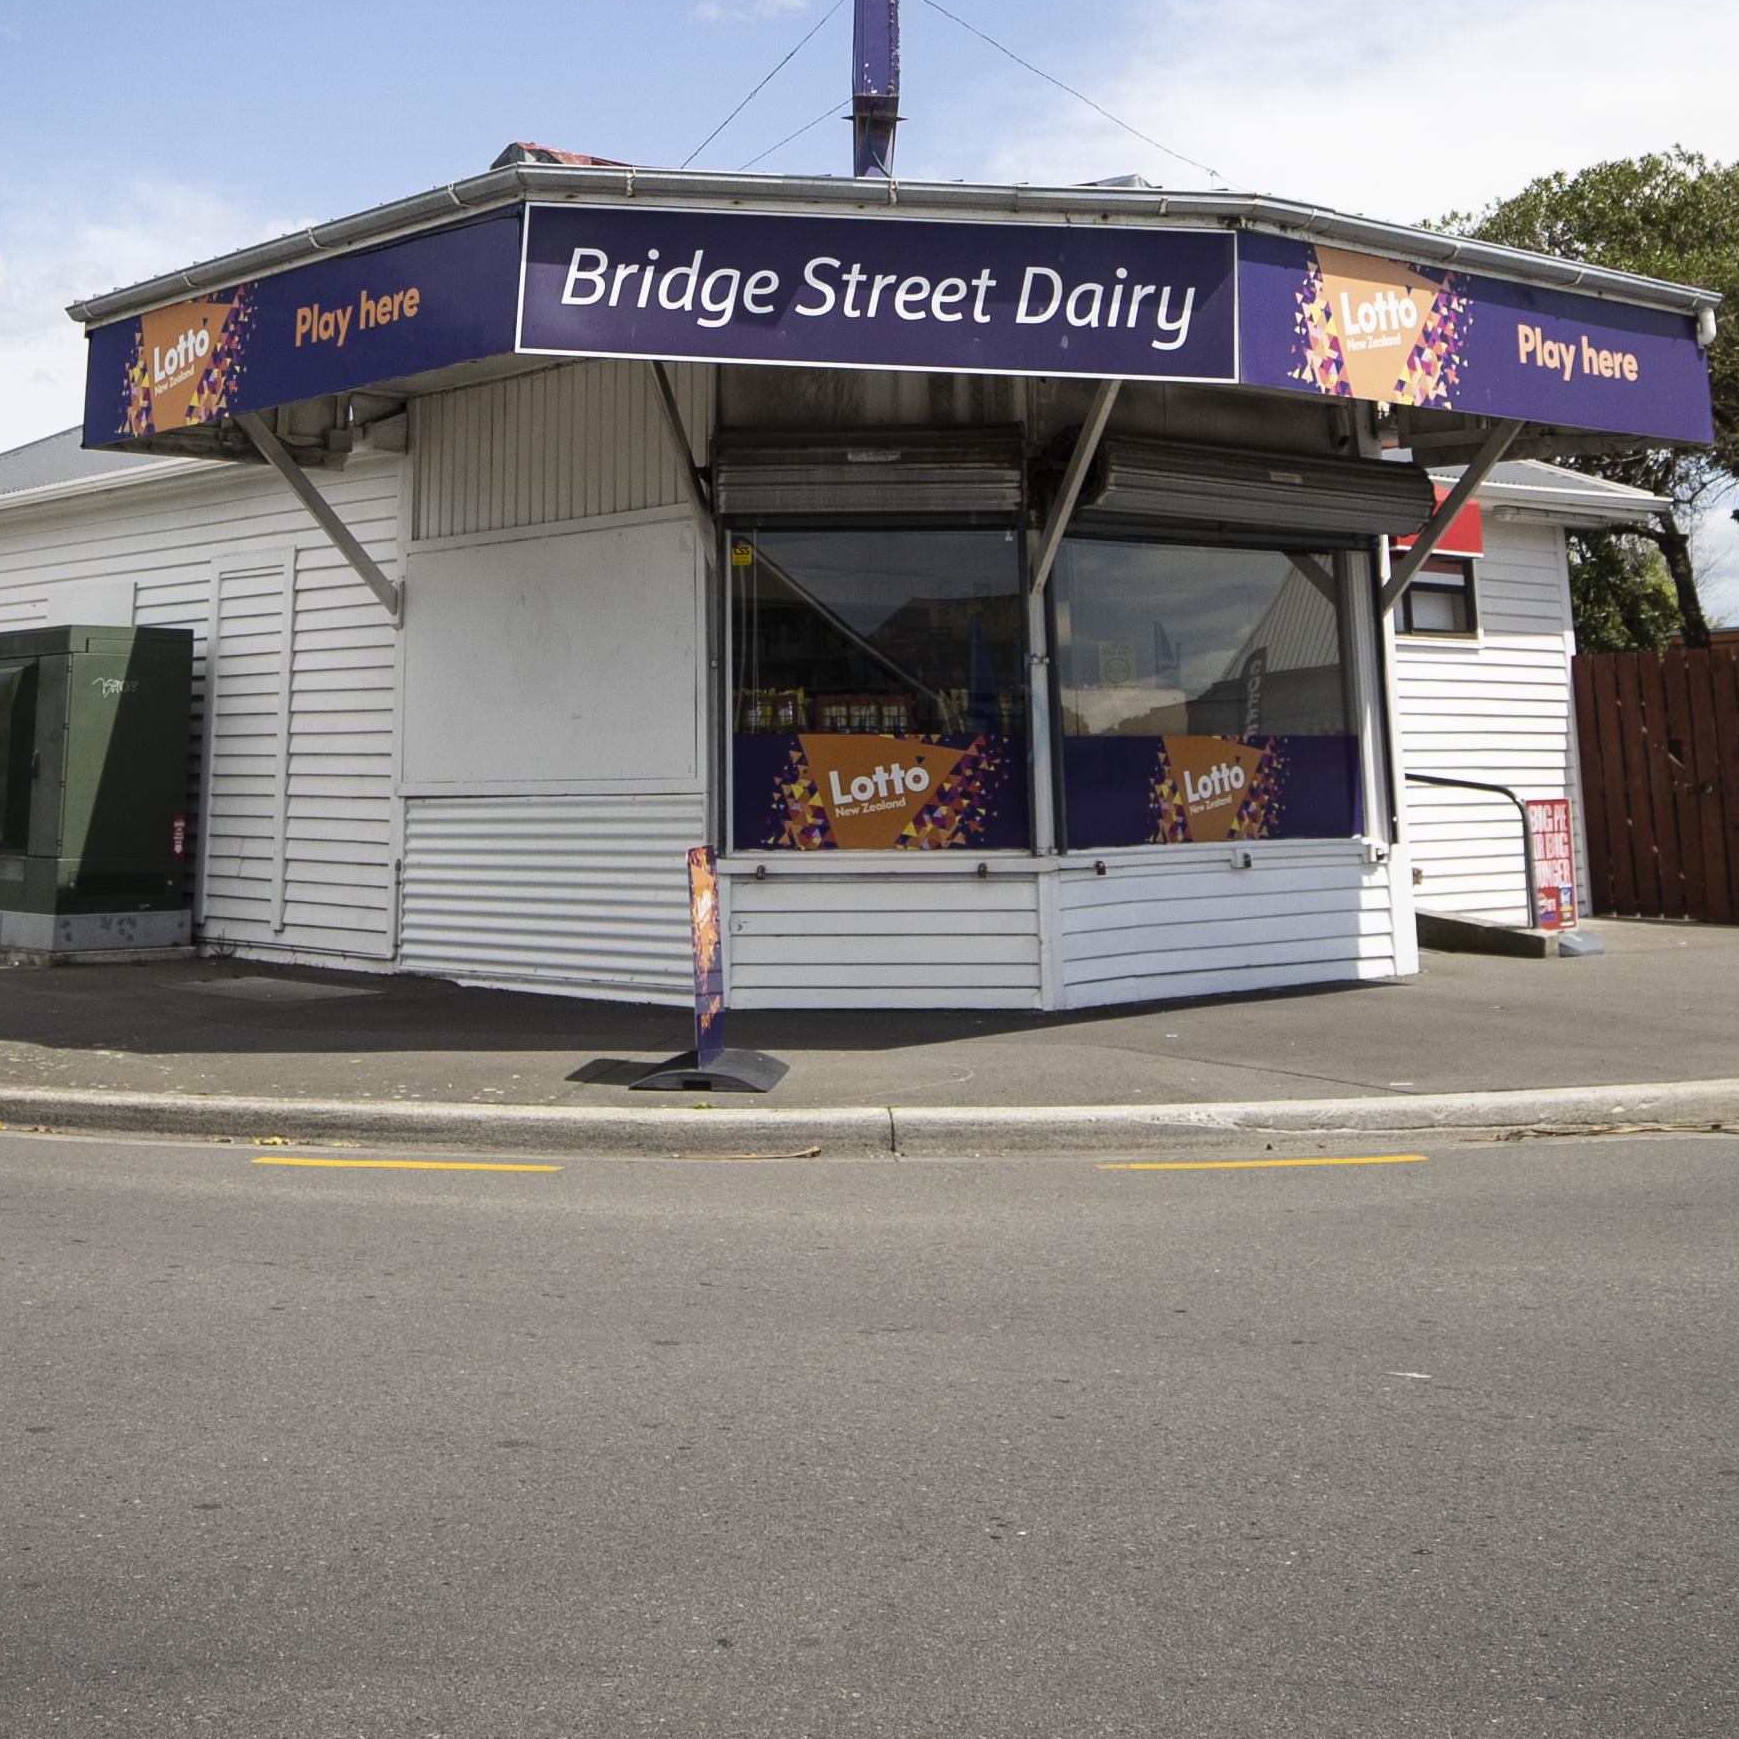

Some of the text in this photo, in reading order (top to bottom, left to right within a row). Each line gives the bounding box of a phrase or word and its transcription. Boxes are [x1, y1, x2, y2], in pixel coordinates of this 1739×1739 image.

[294, 287, 420, 347] Play here
[561, 246, 1196, 351] Bridge Street Dairy
[1339, 290, 1418, 336] Lotto
[153, 328, 210, 384] Lotto
[1347, 333, 1402, 351] New Zealand
[1517, 324, 1639, 381] Play here
[154, 364, 196, 397] New Zealand
[828, 763, 930, 806] Lotto
[1183, 763, 1246, 803] Lotto
[835, 797, 907, 818] New Zealand
[1189, 794, 1233, 816] New Zealand
[1528, 804, 1553, 833] BIG
[1531, 832, 1570, 861] OR BIG
